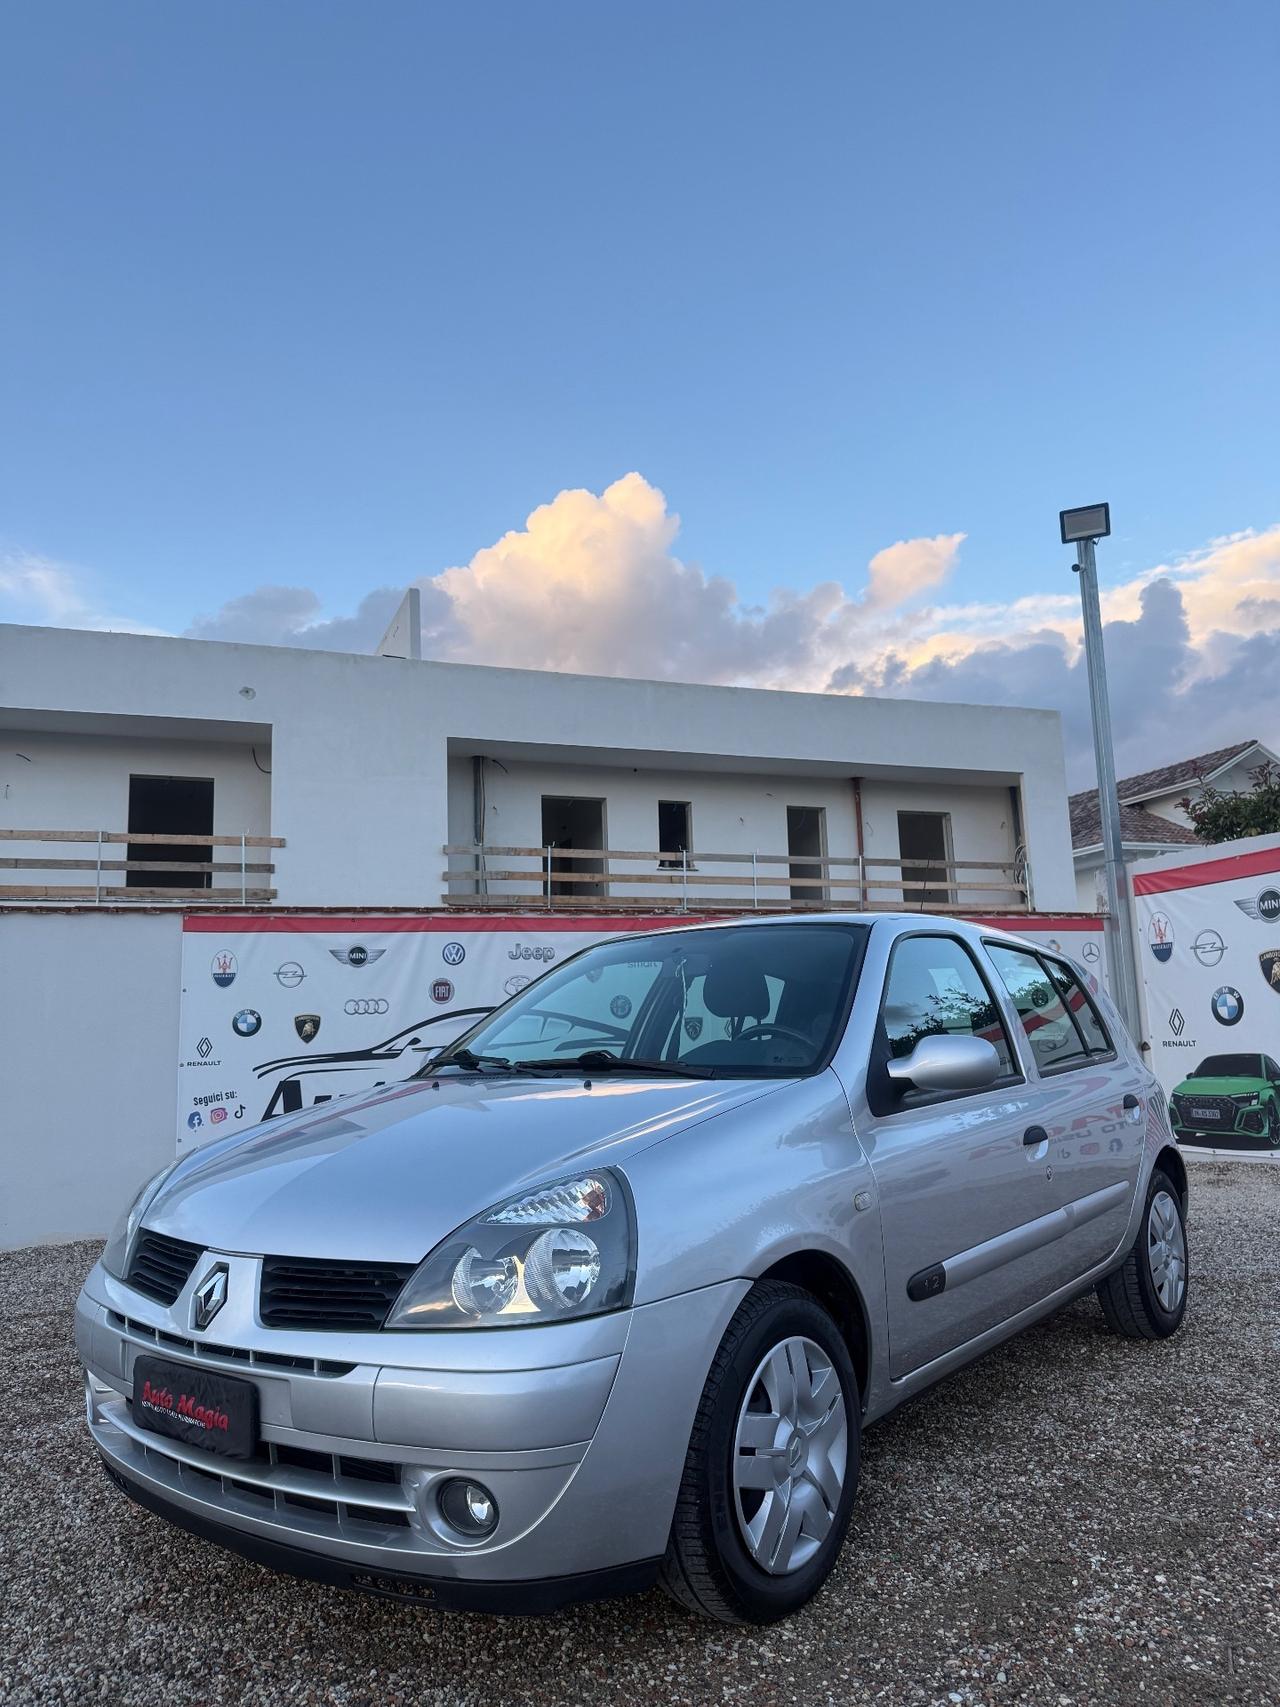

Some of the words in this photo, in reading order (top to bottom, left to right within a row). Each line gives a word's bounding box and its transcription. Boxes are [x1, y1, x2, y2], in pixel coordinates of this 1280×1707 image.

[508, 943, 555, 963] Jeep
[435, 985, 450, 998] FIAT
[1162, 1039, 1197, 1048] RENAULT
[193, 1091, 224, 1106] Seguici
[225, 1090, 238, 1100] su:
[142, 1380, 174, 1409] Auto
[176, 1394, 229, 1432] Magia
